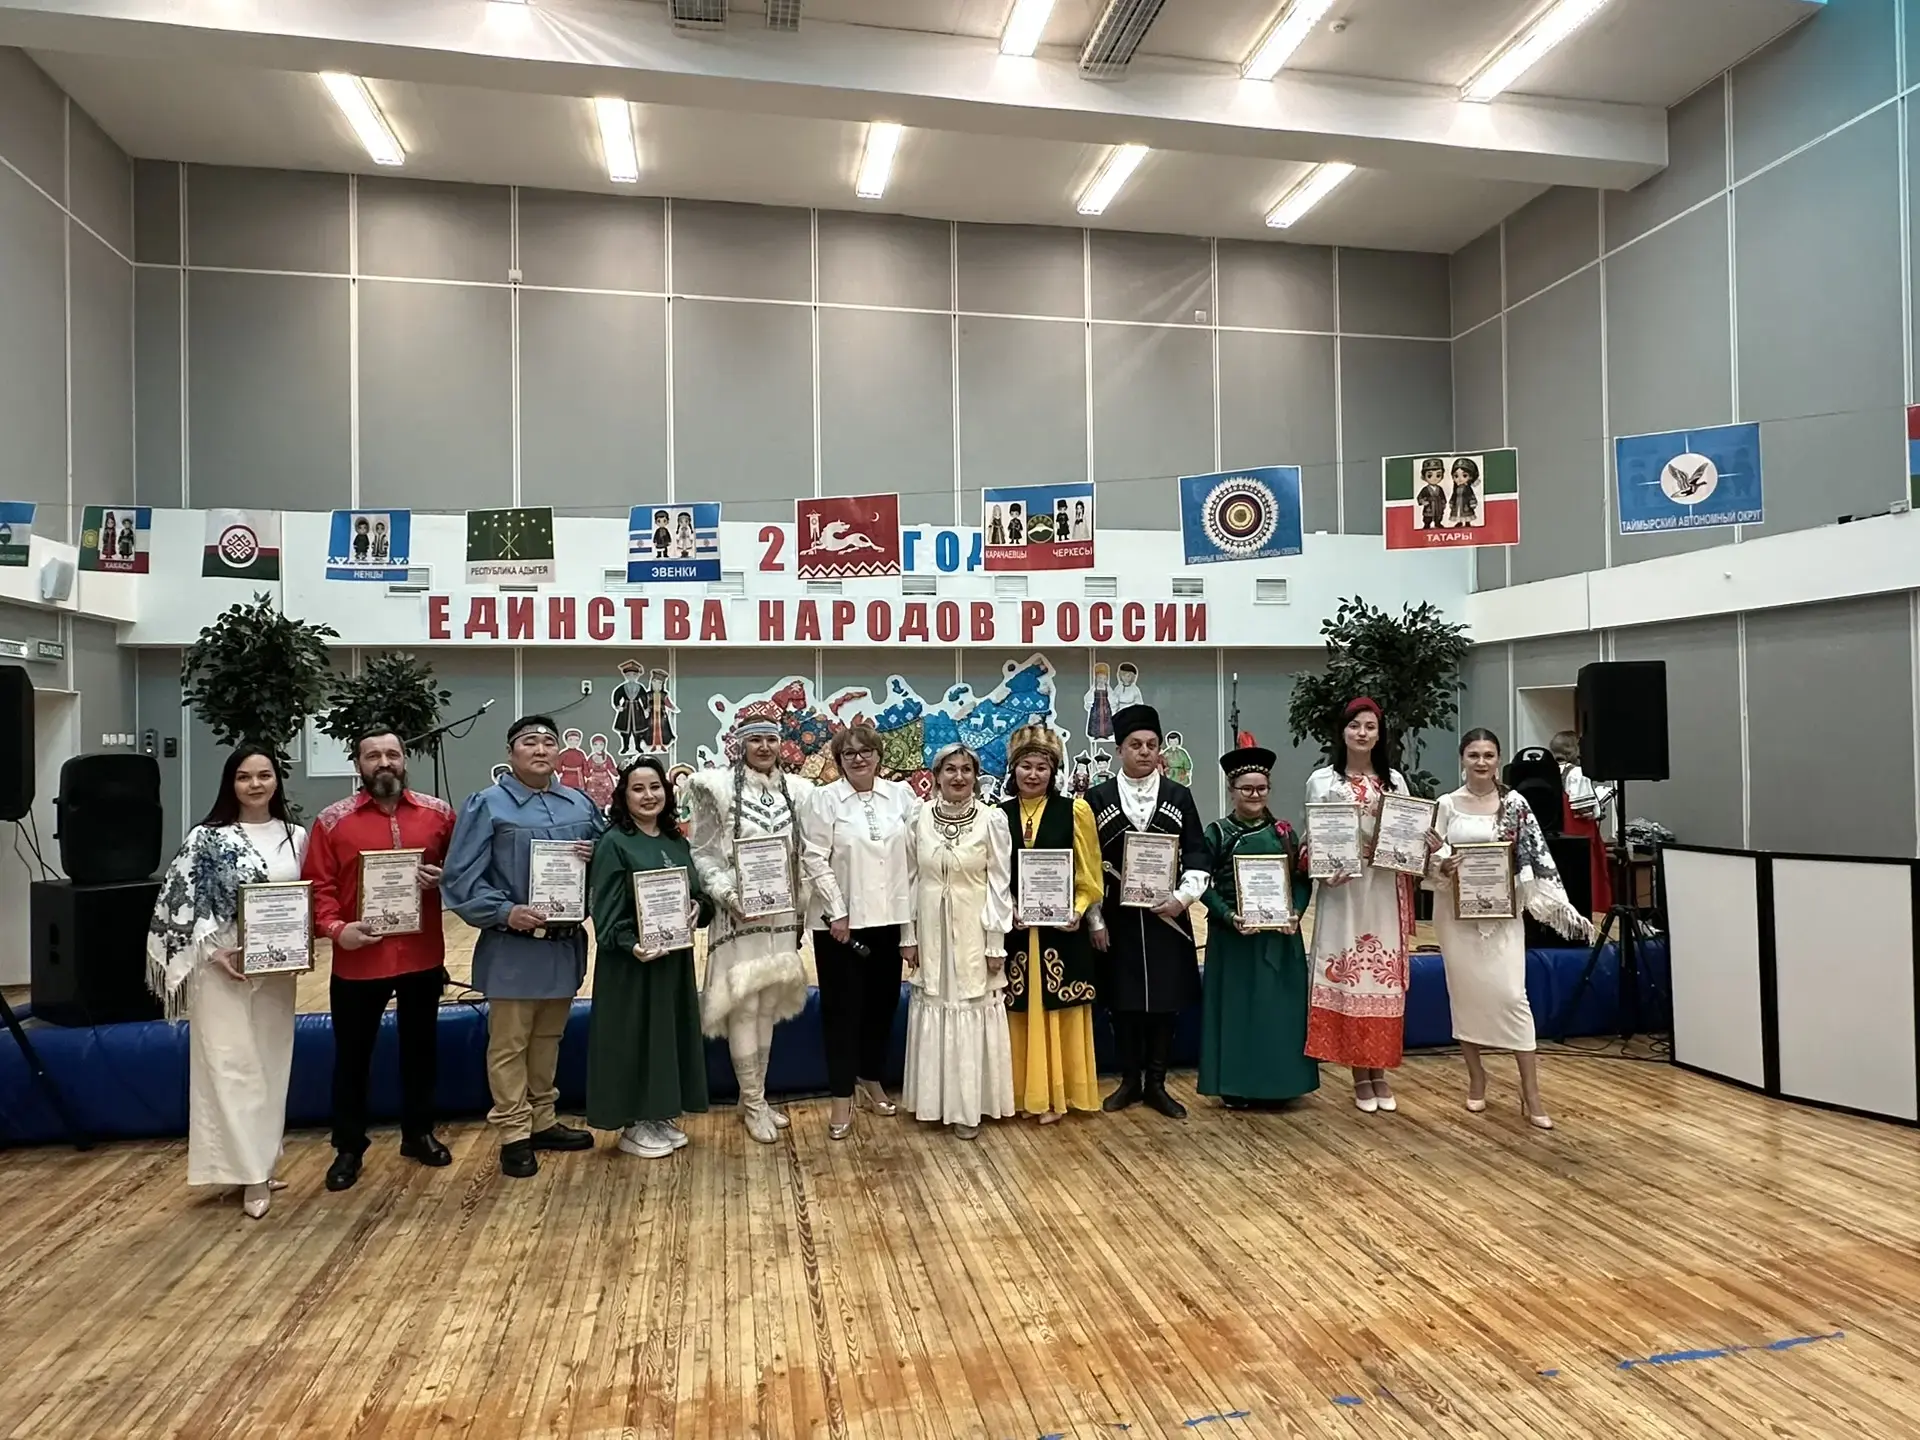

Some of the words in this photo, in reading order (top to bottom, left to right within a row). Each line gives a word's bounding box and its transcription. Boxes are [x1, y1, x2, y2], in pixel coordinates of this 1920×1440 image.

[1621, 515, 1677, 531] ТАЙМЫРСКИЙ
[1678, 510, 1736, 526] АВТОНОМНЫЙ
[1737, 509, 1761, 522] ОКРУГ
[1426, 532, 1472, 542] ТАТАРЫ
[985, 550, 1027, 559] КАРАЧАЕВЦЫ
[1052, 546, 1092, 557] ЧЕРКЕСЫ
[353, 570, 383, 579] НЕНЦЫ
[471, 566, 517, 575] РЕСПУБЛИКА
[518, 565, 548, 575] АДЫГЕЯ
[651, 566, 697, 578] ЭВЕНКИ
[428, 596, 728, 641] ЕДИНСТВА
[758, 599, 995, 642] НАРОДОВ
[1021, 600, 1207, 643] РОССИИ
